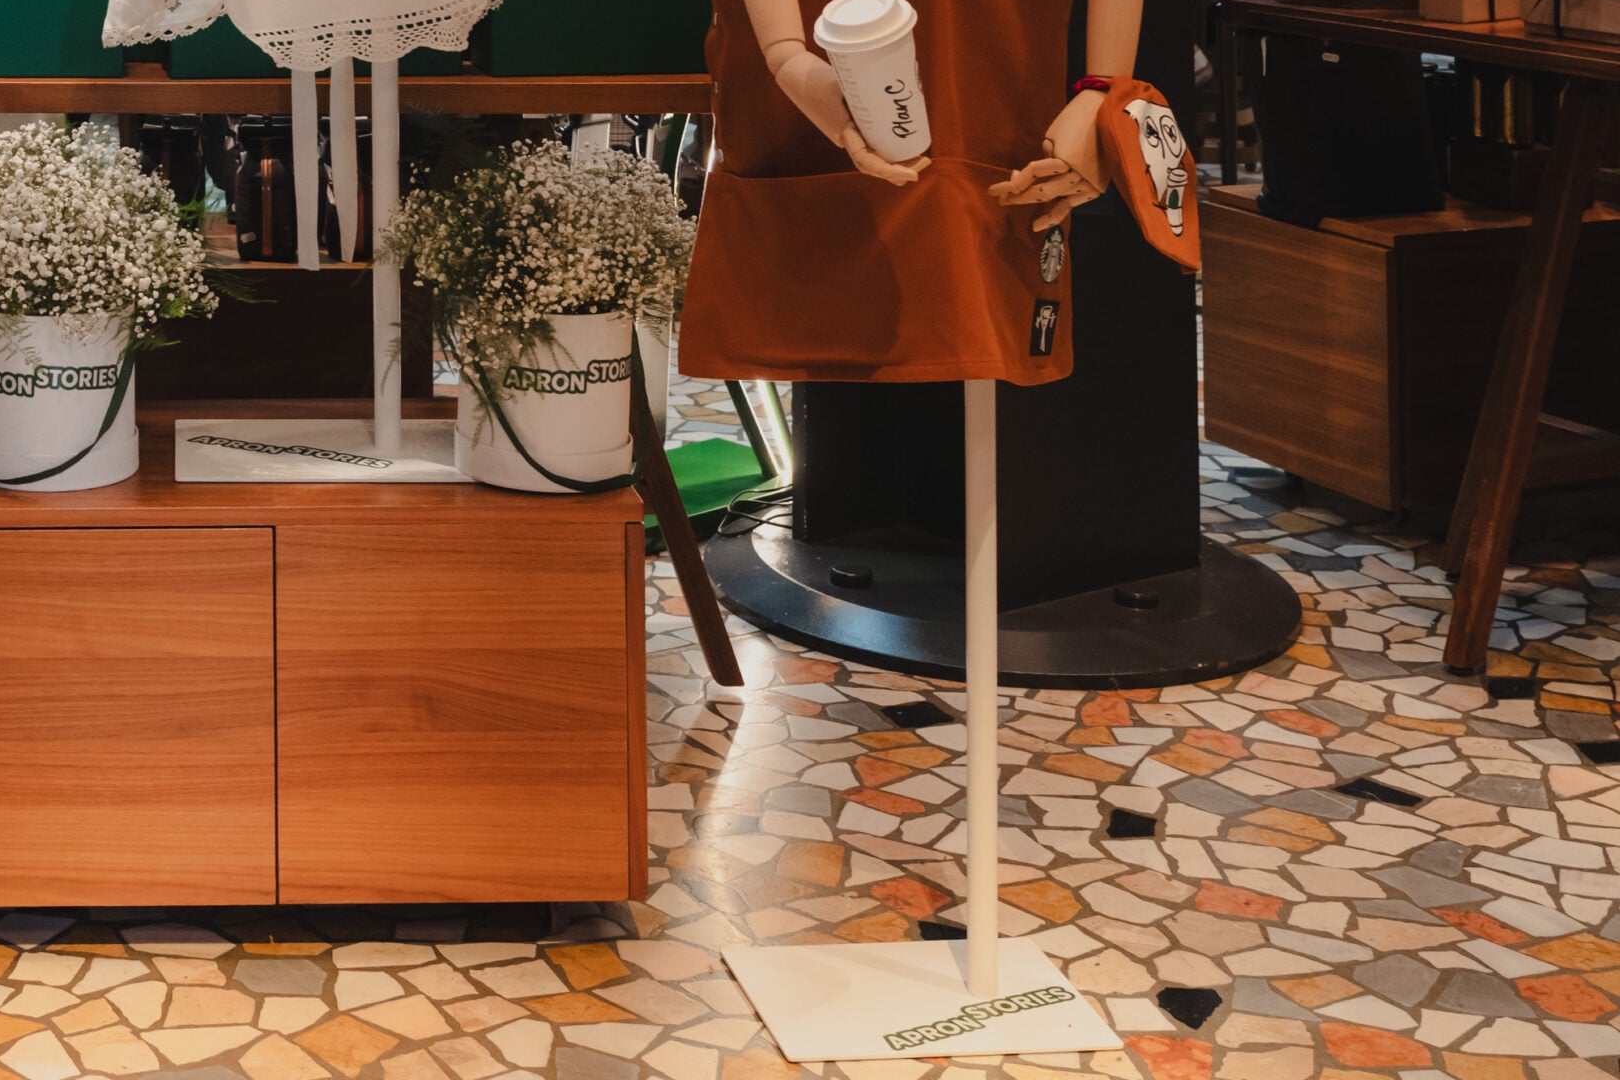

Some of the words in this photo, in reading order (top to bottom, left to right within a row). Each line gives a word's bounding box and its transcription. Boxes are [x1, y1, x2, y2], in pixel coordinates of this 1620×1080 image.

[884, 78, 906, 95] C
[35, 366, 118, 389] STORIES
[505, 367, 586, 393] APRON
[189, 435, 283, 454] APRON
[285, 445, 391, 469] STORIES
[887, 1016, 983, 1050] APRON
[963, 987, 1074, 1020] STORIES
